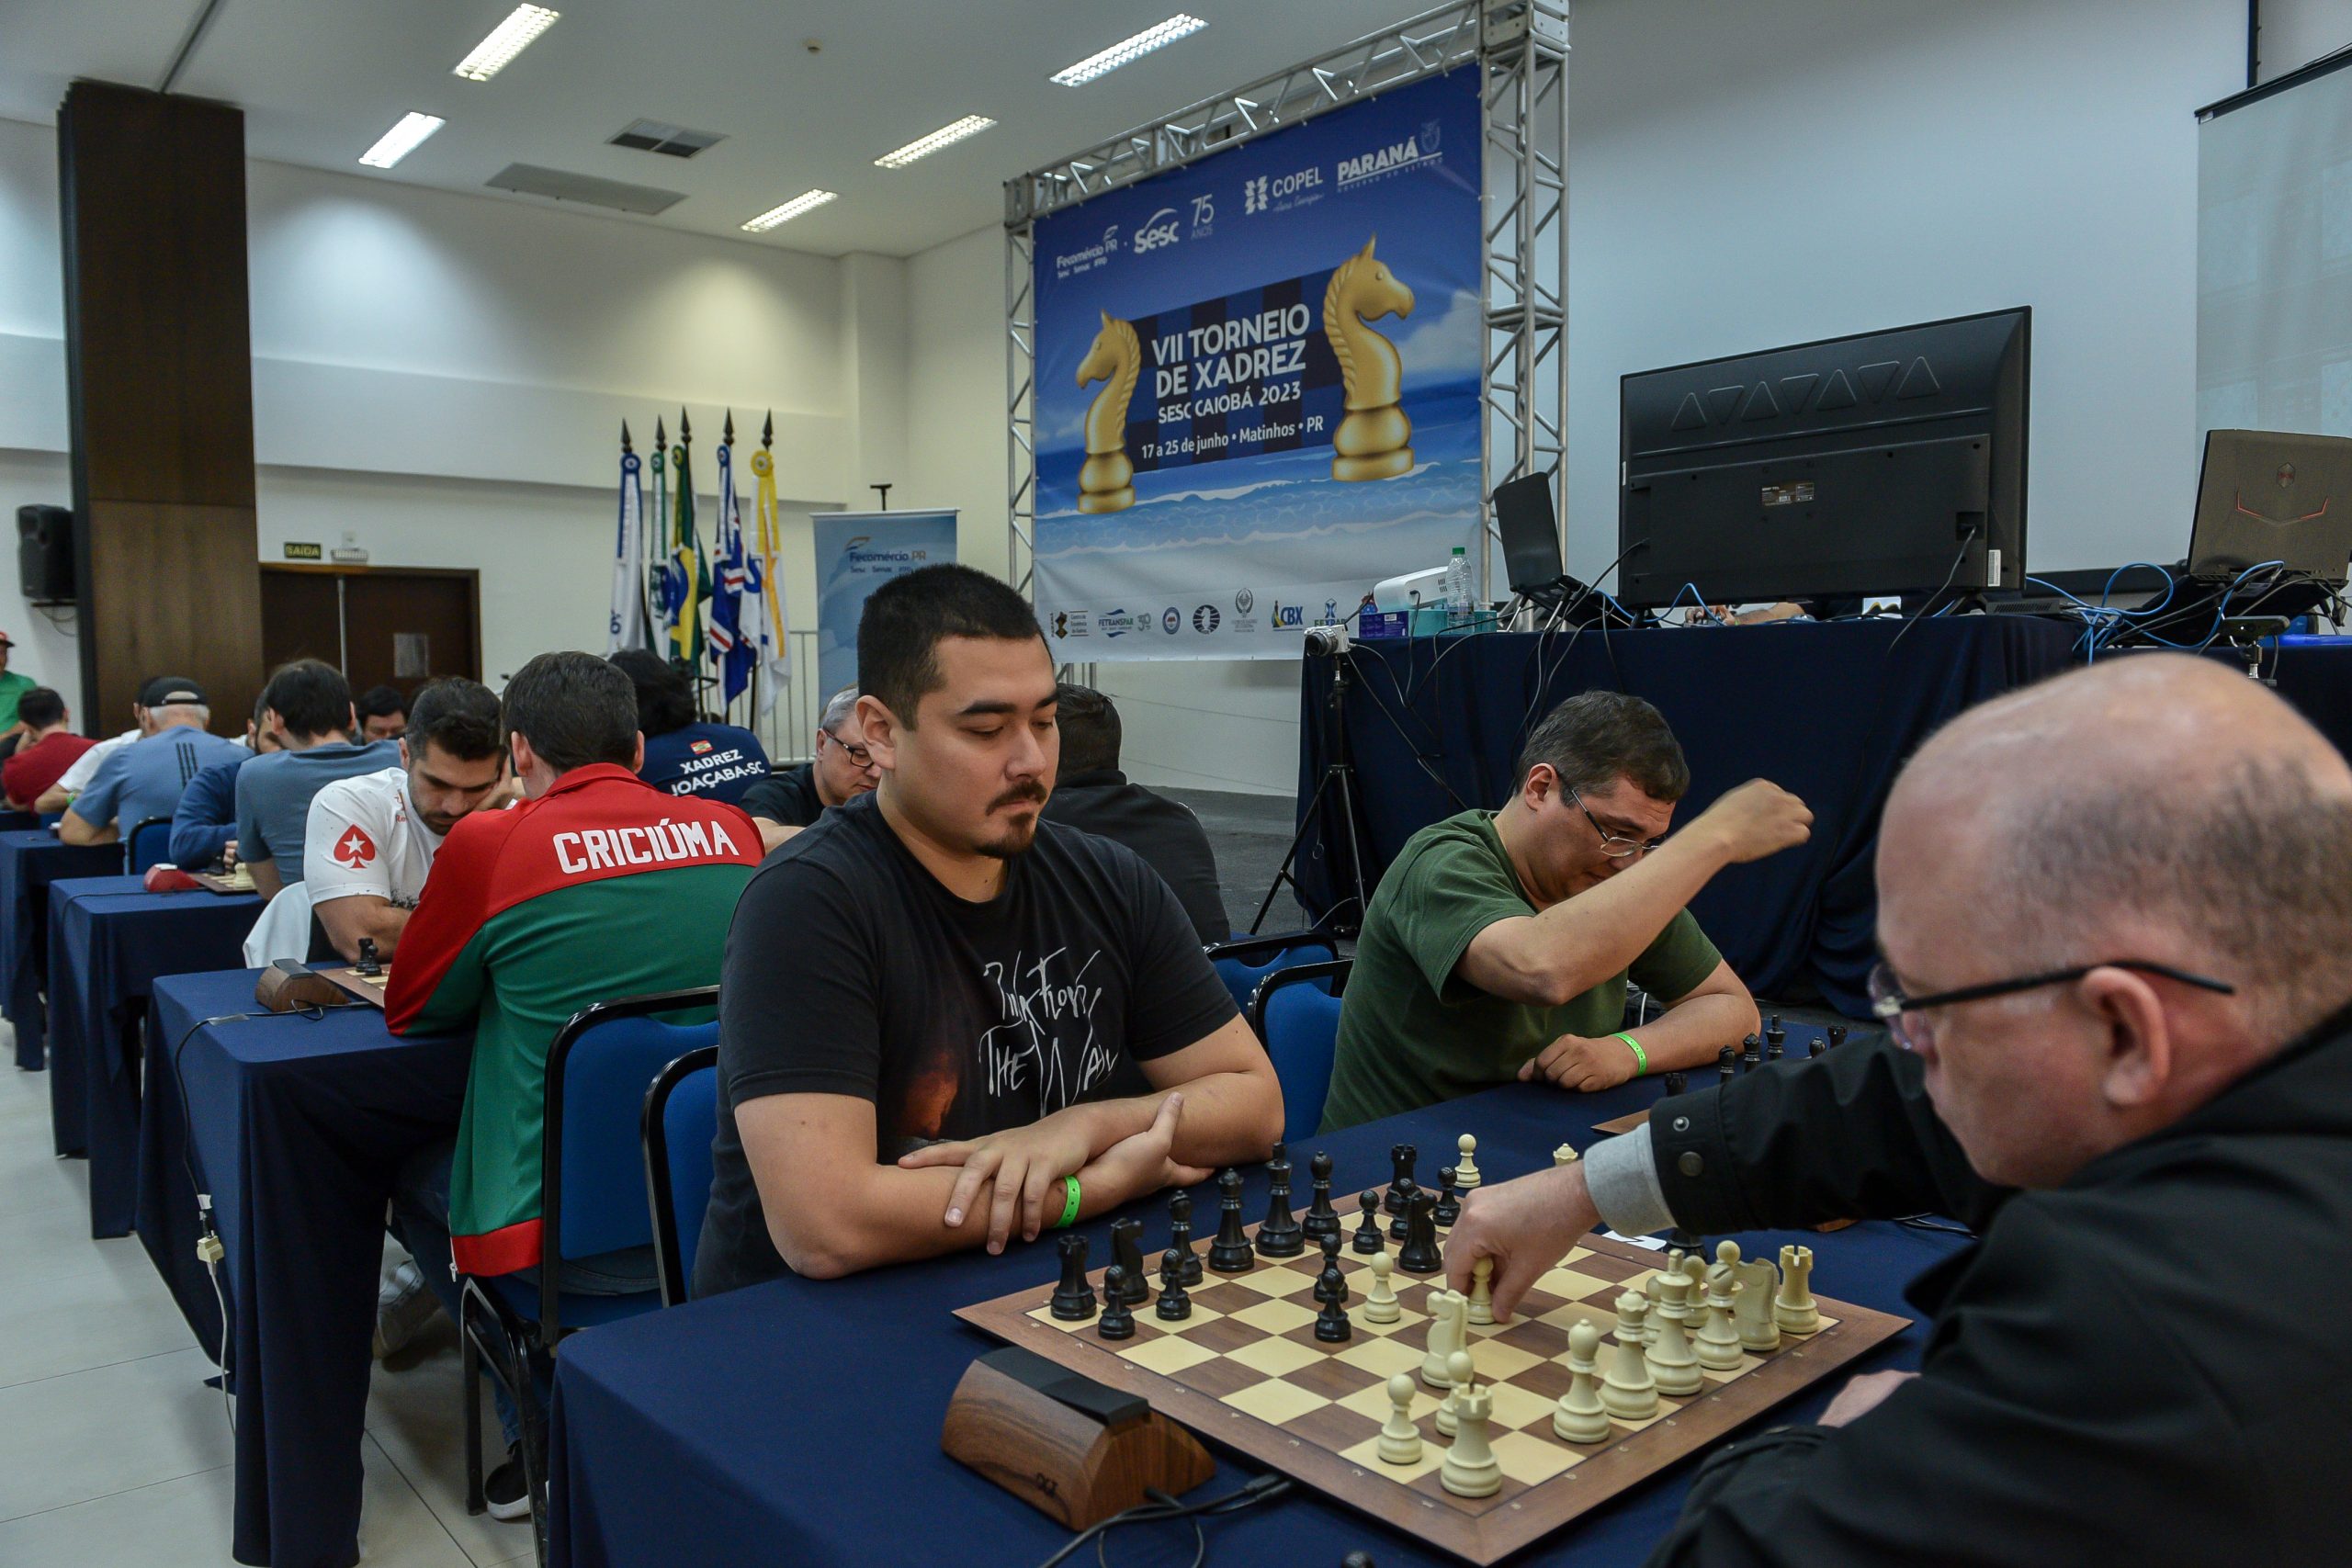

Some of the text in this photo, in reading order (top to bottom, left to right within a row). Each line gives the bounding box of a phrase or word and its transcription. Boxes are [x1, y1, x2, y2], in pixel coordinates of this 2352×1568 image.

[1338, 136, 1419, 181] PARANÁ
[1272, 166, 1324, 197] COPEL
[1191, 193, 1214, 228] 75
[1151, 303, 1311, 367] VII TORNEIO
[1156, 339, 1306, 400] DE XADREZ
[1158, 381, 1301, 424] SESC CAIOBÁ 2023
[1141, 415, 1324, 458] 17 a 25 de junho Matinhos PR
[911, 550, 926, 561] PR
[1281, 606, 1303, 626] CBX
[671, 761, 765, 797] JOAÇABA-SC
[679, 749, 743, 774] XADREZ
[552, 818, 740, 874] CRICIÚMA
